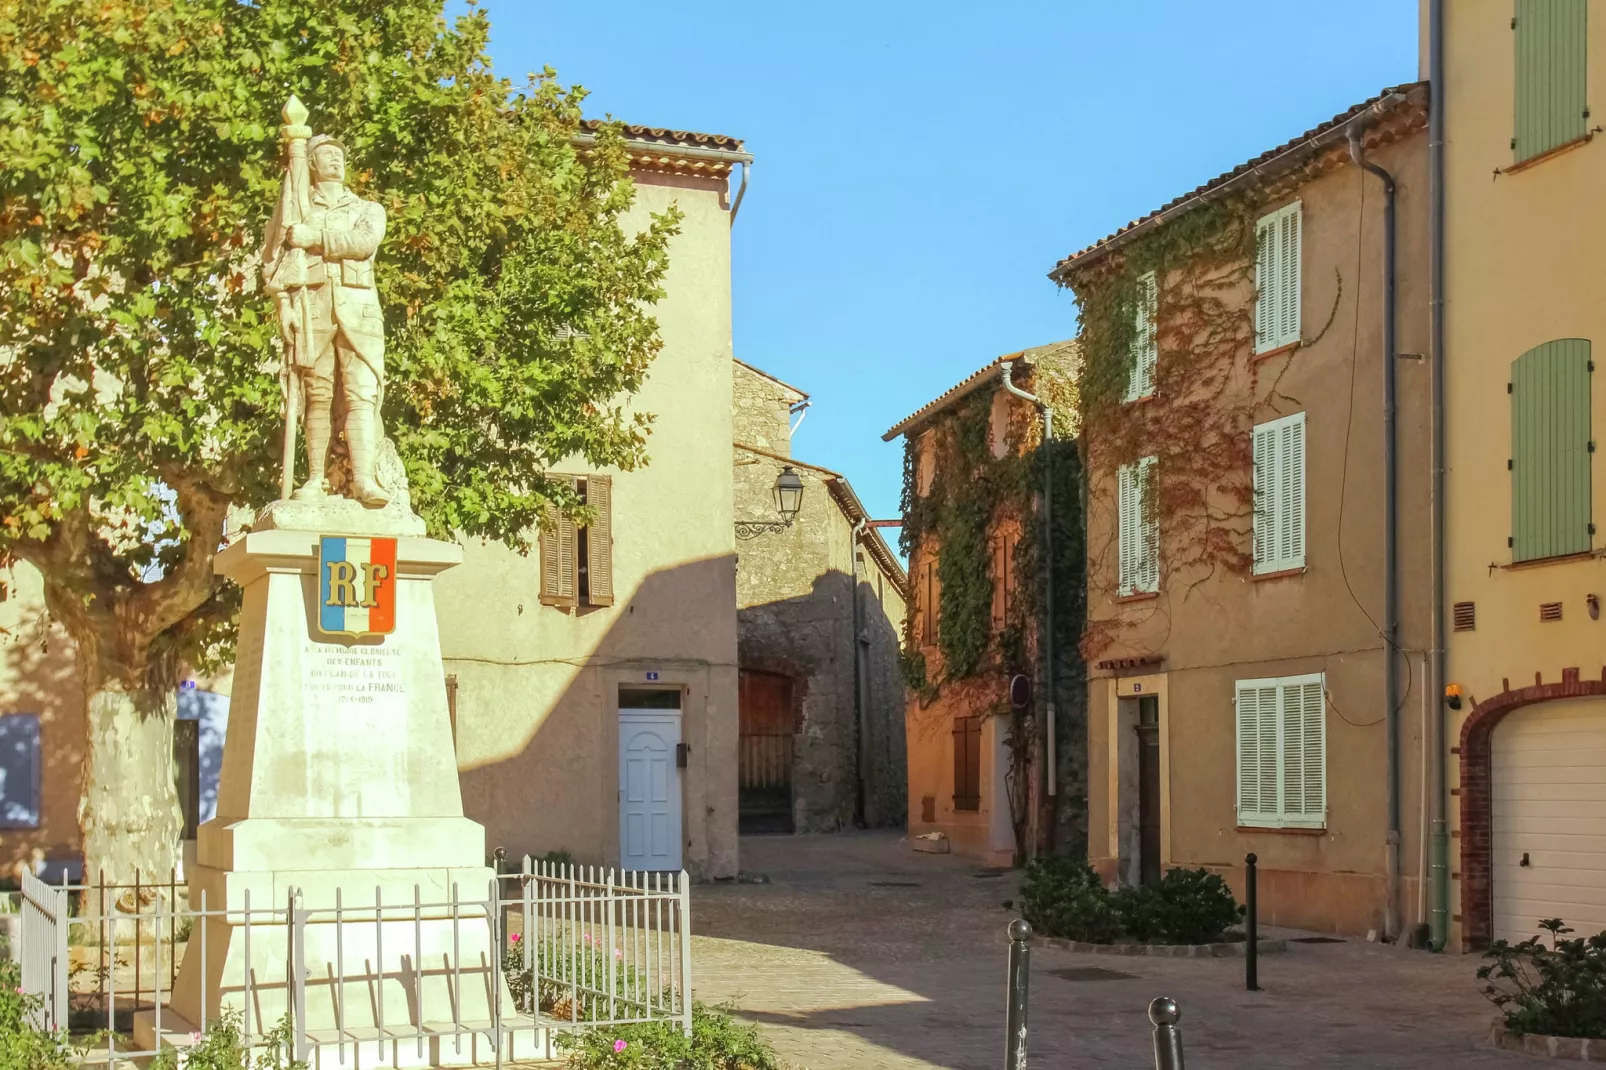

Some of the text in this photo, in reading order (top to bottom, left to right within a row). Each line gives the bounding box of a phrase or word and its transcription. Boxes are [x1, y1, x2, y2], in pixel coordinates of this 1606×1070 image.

[325, 561, 388, 608] RF
[345, 658, 382, 667] ENFANTS
[356, 684, 366, 692] LA
[368, 682, 406, 692] FRANCE
